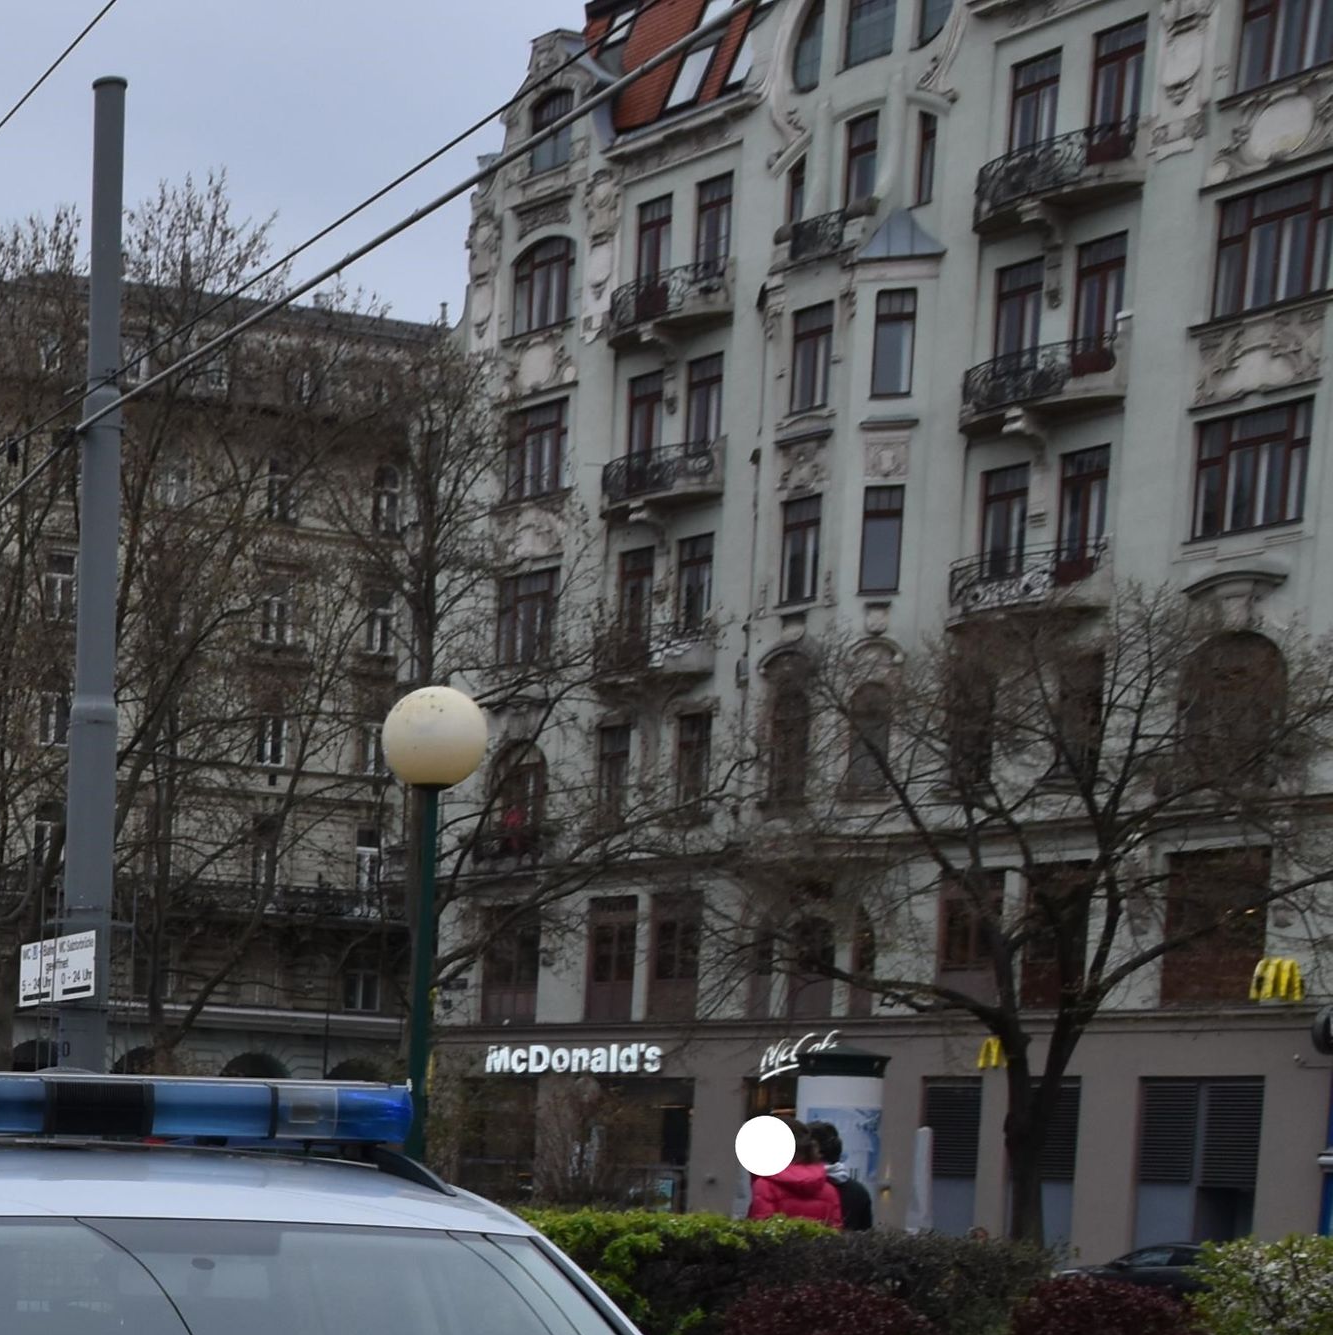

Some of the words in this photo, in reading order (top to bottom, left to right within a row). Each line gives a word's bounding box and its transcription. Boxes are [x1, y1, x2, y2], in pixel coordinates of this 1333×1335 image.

[73, 970, 80, 983] 24
[82, 968, 92, 981] Uhr
[485, 1043, 663, 1073] McDonald's
